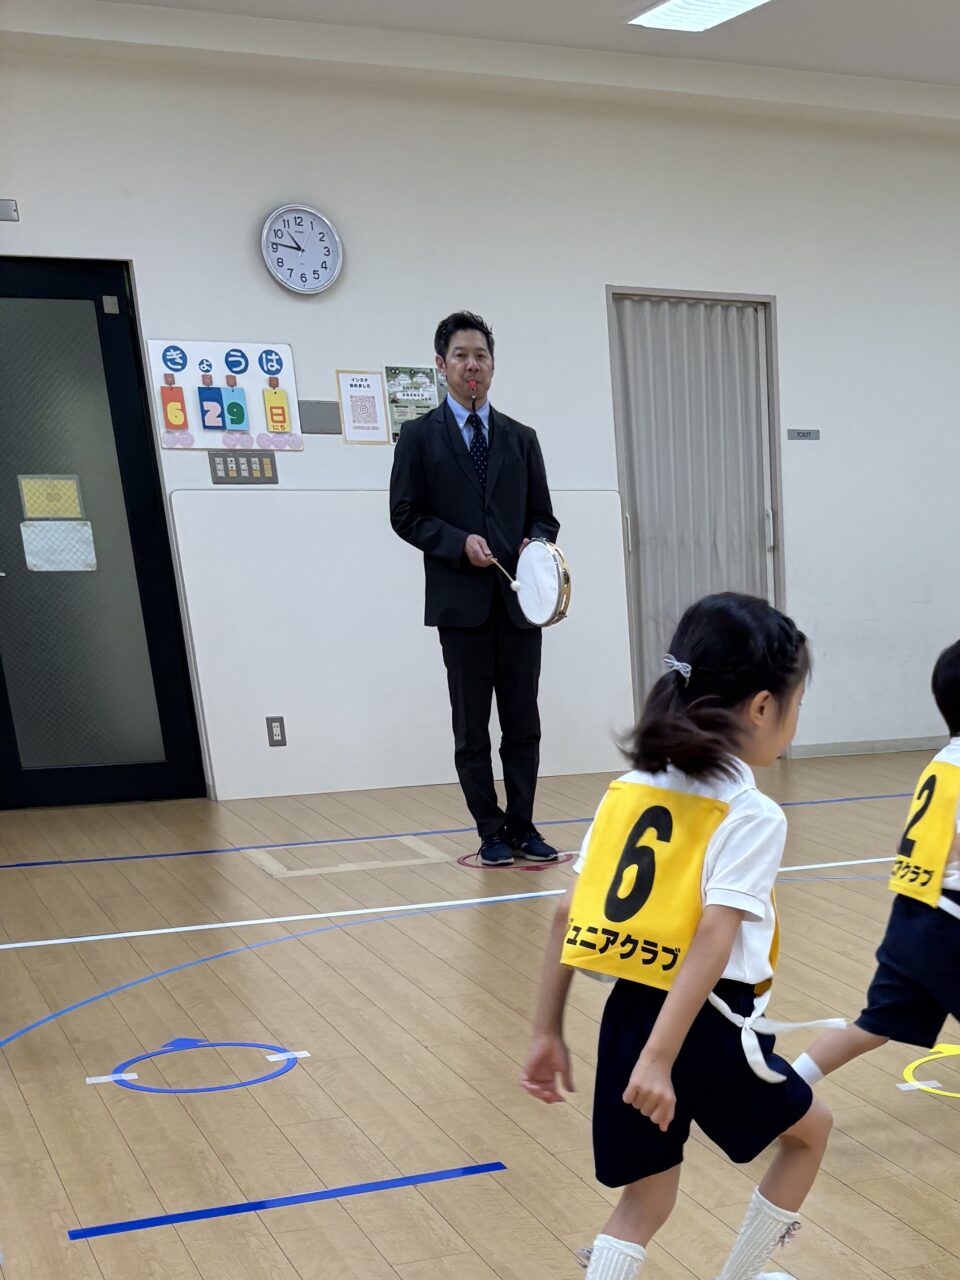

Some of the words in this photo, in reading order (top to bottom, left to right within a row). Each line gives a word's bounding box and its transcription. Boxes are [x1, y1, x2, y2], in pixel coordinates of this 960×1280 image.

[282, 219, 290, 229] 11
[293, 216, 304, 227] 12
[310, 221, 314, 231] 1
[273, 229, 284, 239] 10
[318, 232, 326, 242] 2
[271, 242, 279, 253] 9
[323, 246, 331, 257] 3
[276, 257, 285, 268] 8
[320, 260, 328, 271] 4
[286, 267, 294, 278] 7
[300, 272, 308, 283] 6
[312, 269, 320, 280] 5
[166, 401, 185, 426] 6
[897, 774, 937, 858] 2
[604, 805, 673, 923] 6
[566, 919, 681, 971] ュニアクラブ
